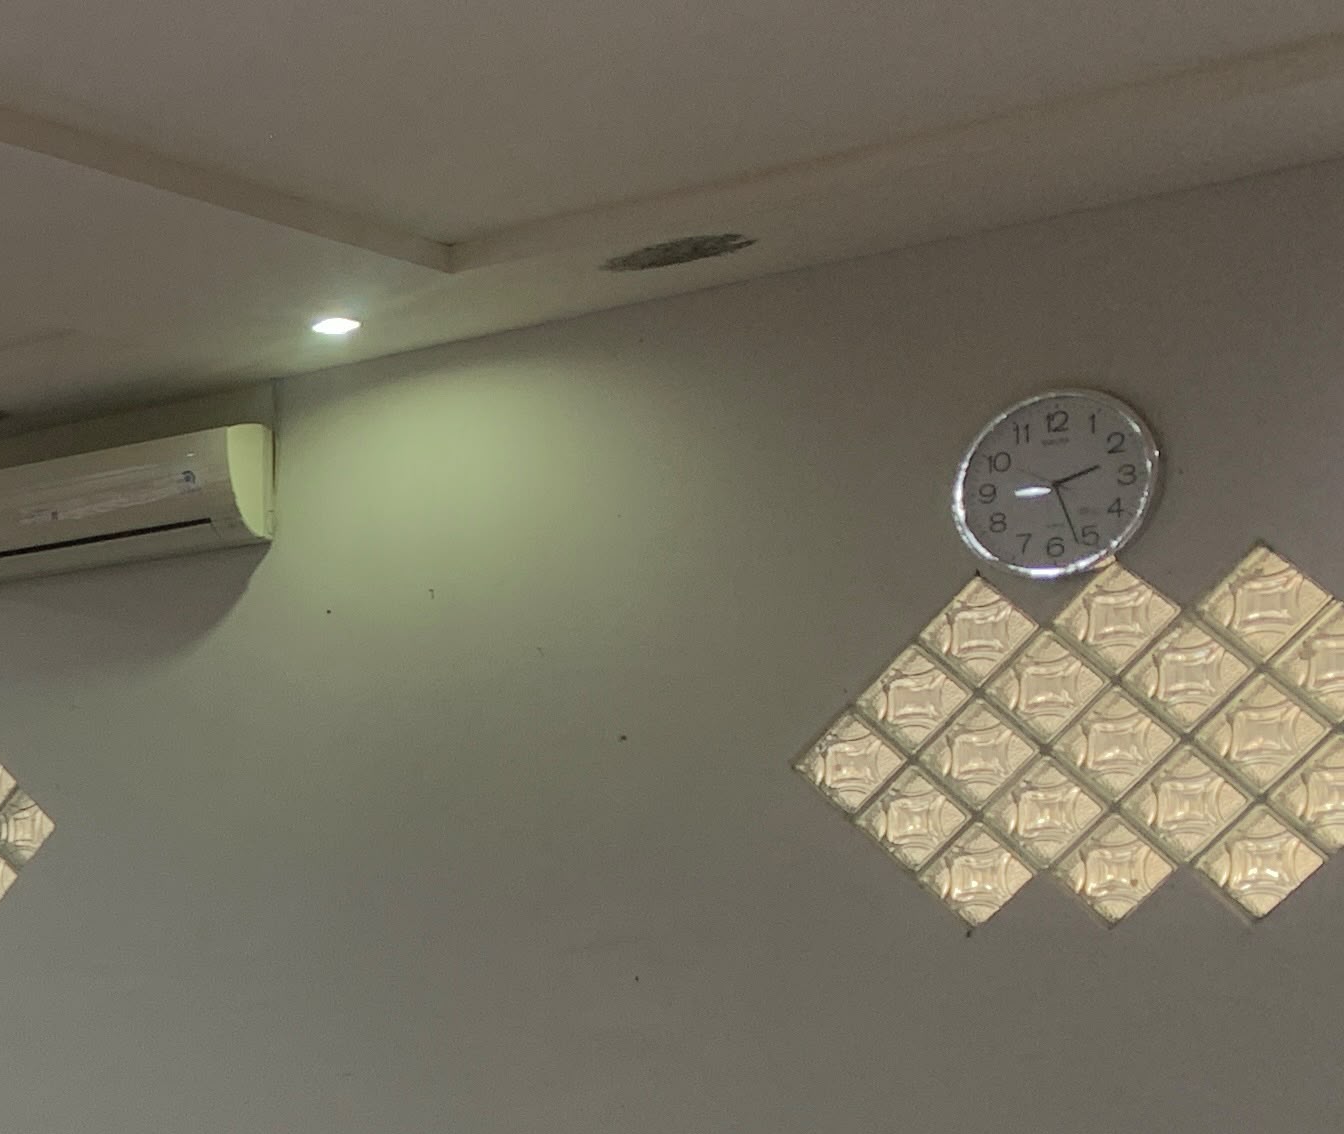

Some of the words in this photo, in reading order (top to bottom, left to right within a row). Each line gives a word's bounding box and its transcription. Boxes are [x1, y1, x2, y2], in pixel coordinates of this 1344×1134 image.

[1046, 410, 1069, 433] 12
[1013, 422, 1030, 444] 11
[1107, 432, 1125, 454] 2
[987, 452, 1011, 473] 10
[1117, 464, 1137, 485] 3
[979, 483, 997, 504] 9
[1107, 498, 1124, 518] 4
[989, 512, 1007, 533] 8
[1016, 533, 1032, 554] 7
[1081, 525, 1099, 546] 5
[1046, 537, 1065, 557] 6
